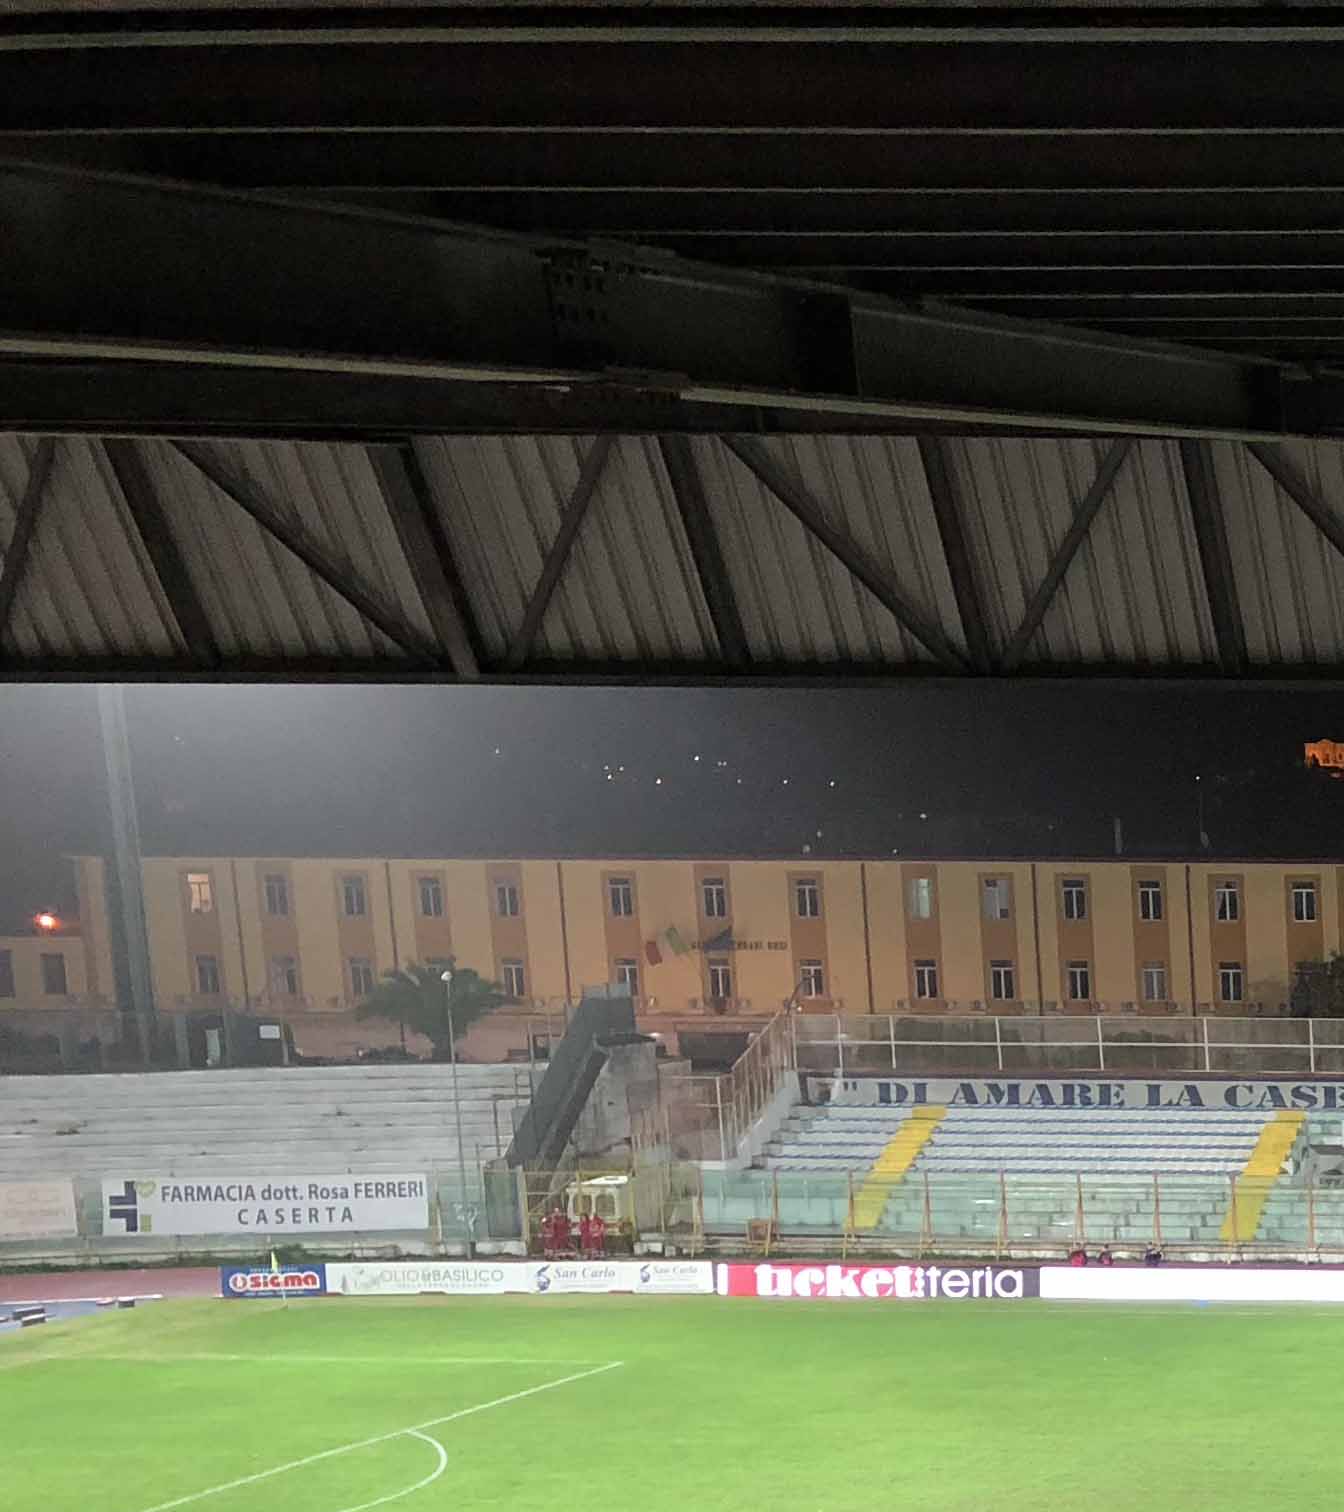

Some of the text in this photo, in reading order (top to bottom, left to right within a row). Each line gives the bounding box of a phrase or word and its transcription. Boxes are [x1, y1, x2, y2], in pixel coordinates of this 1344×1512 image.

[876, 1082, 929, 1105] DI
[950, 1082, 1126, 1107] AMARE
[1146, 1084, 1206, 1108] LA
[160, 1180, 424, 1203] FARMACIA dott. Rosa FERRERI
[237, 1206, 354, 1226] CASERTA
